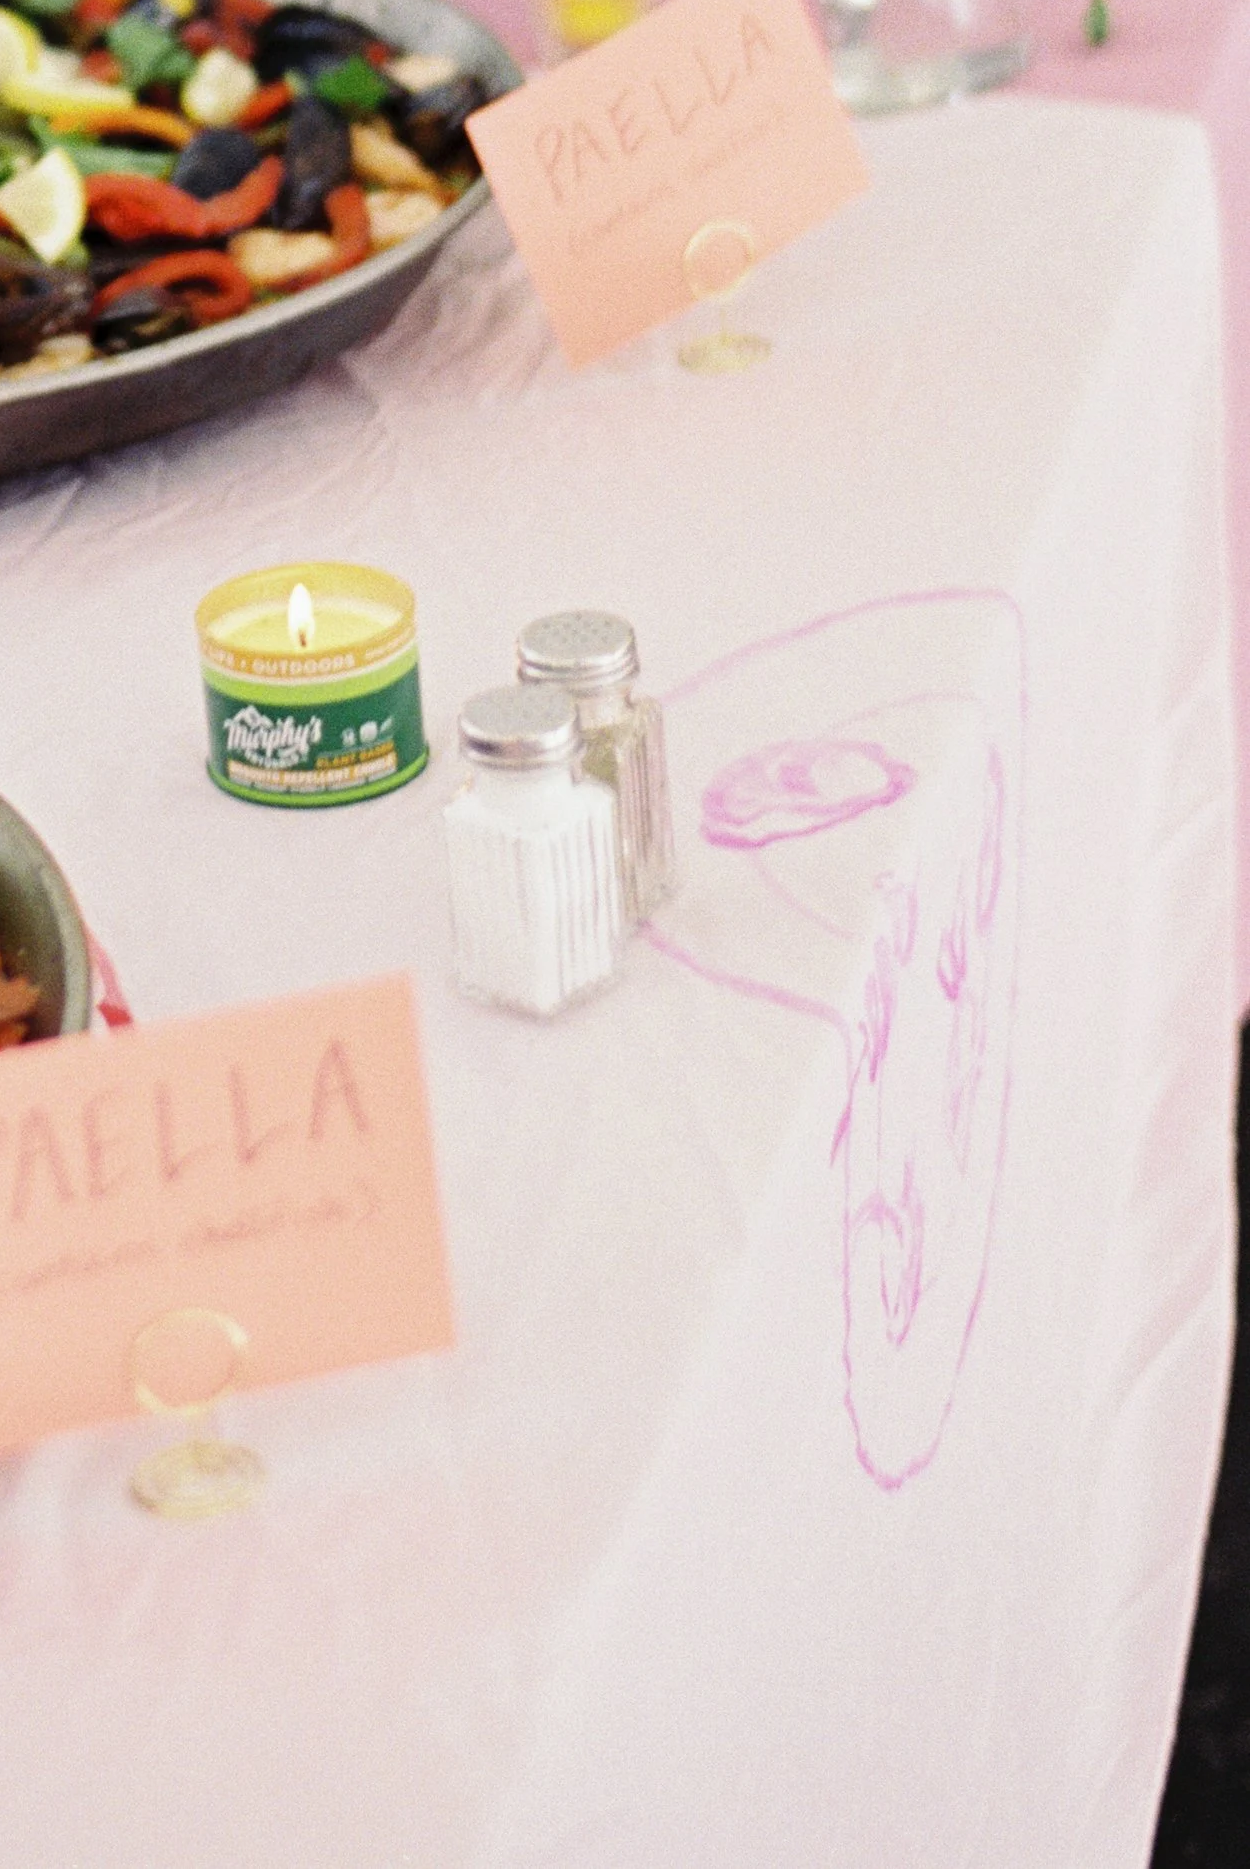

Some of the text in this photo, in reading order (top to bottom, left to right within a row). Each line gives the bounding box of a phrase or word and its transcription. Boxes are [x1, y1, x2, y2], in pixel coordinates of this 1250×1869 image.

[534, 13, 774, 205] PAELLA
[252, 654, 355, 675] OUTDOORS
[224, 714, 323, 759] Murphy's
